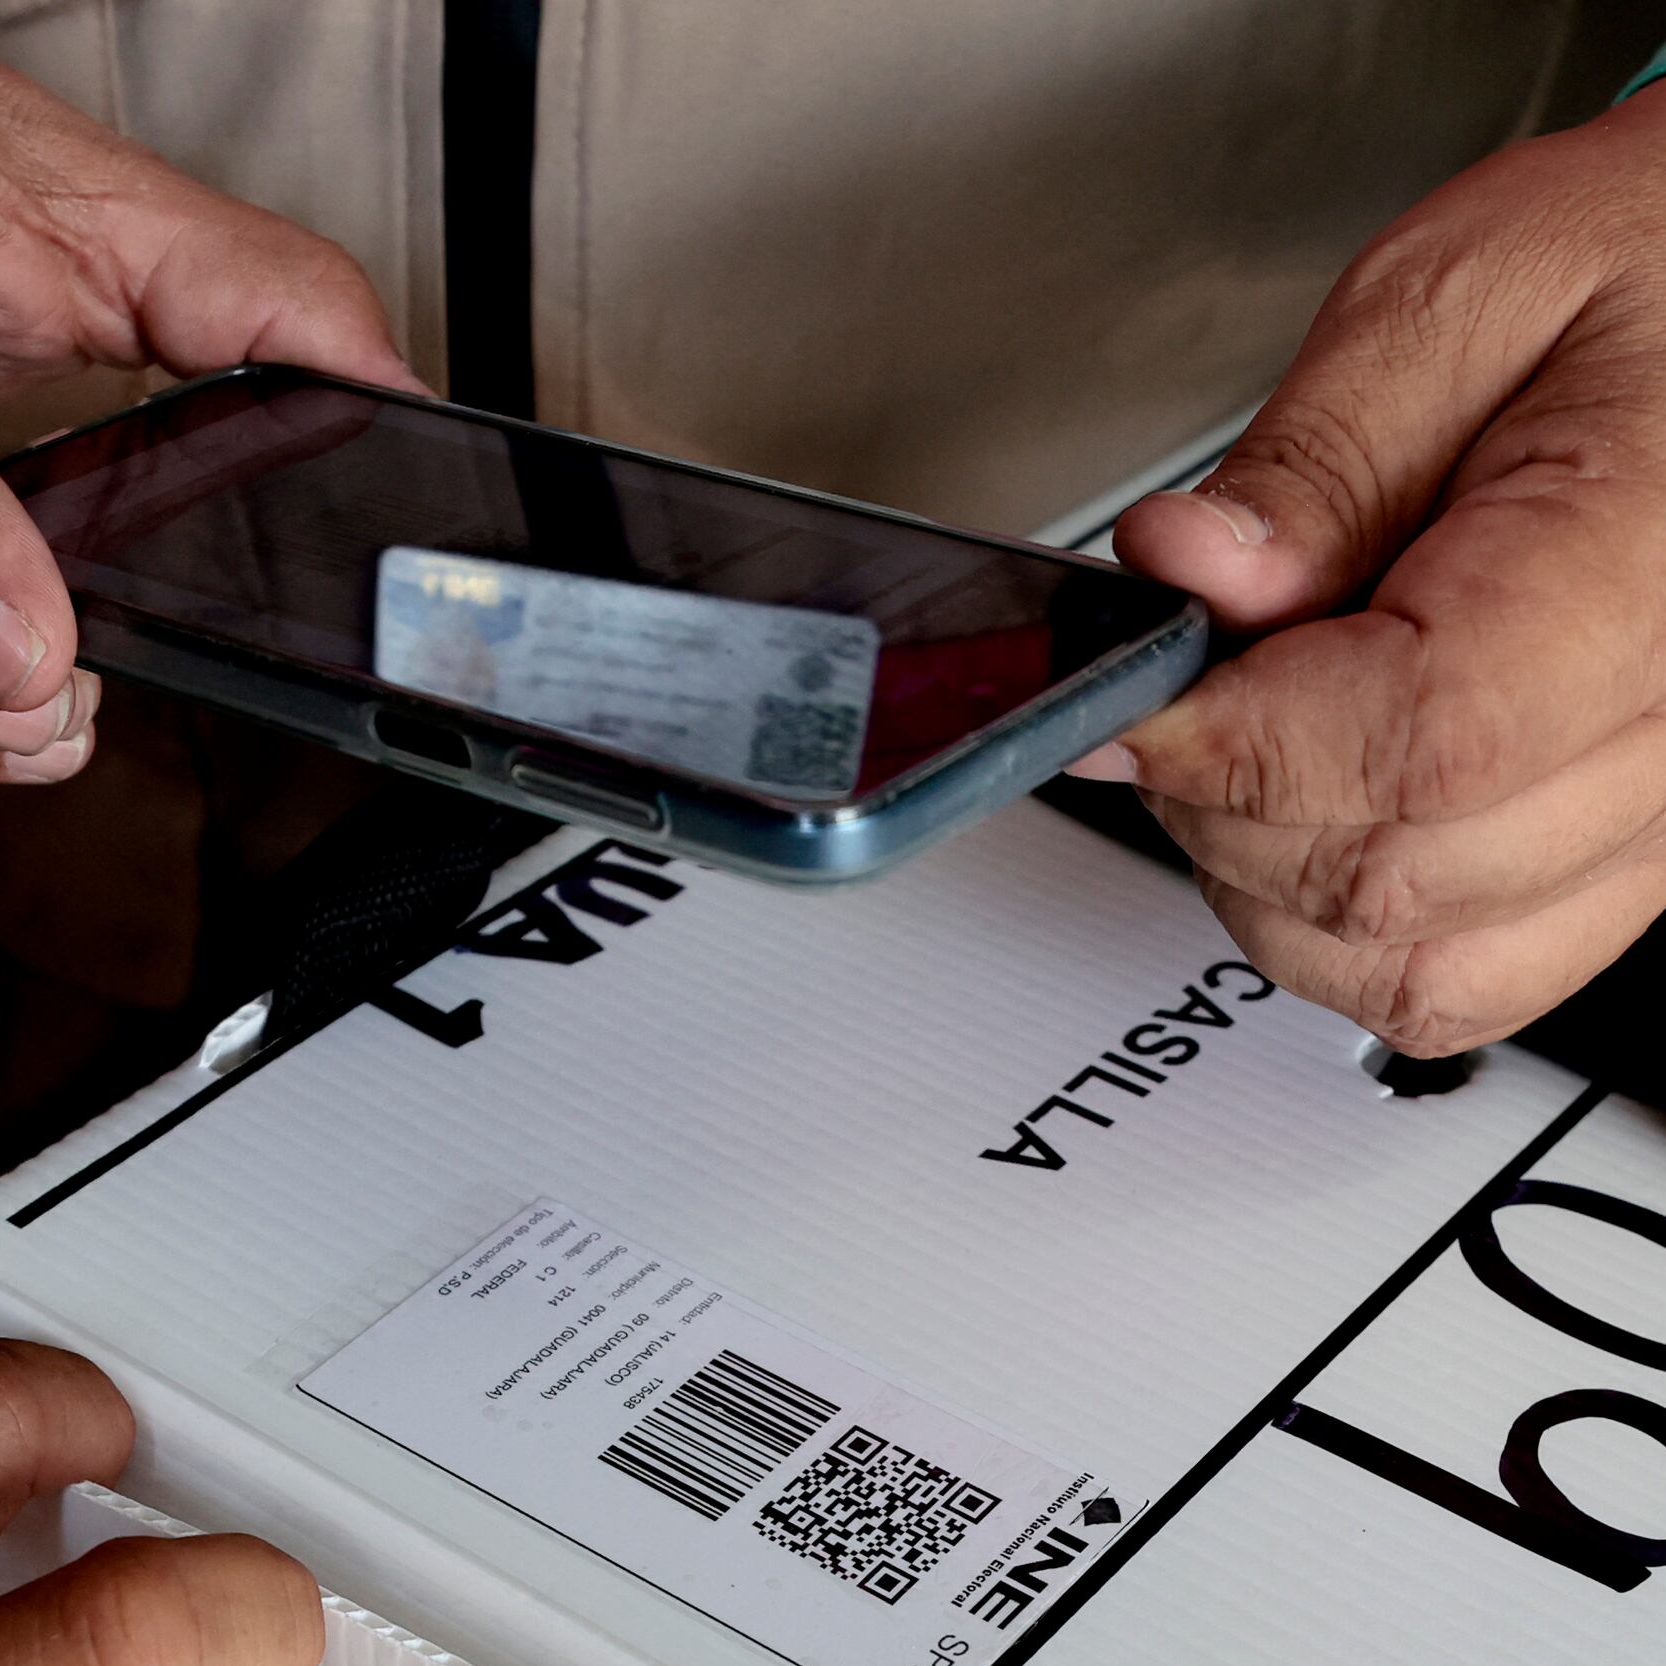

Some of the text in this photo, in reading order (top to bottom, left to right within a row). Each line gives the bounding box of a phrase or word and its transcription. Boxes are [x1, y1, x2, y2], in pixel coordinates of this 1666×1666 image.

[367, 838, 686, 1048] UA 1
[978, 961, 1276, 1170] CASILLA
[470, 1258, 527, 1299] FEDERAL
[547, 1285, 576, 1307] 1214
[578, 1304, 606, 1327] 0041
[632, 1313, 650, 1327] 09
[660, 1330, 676, 1343] 14
[623, 1377, 664, 1410] 175438
[951, 1473, 1094, 1608] Instituto Nacional Electoral
[969, 1527, 1089, 1630] INE
